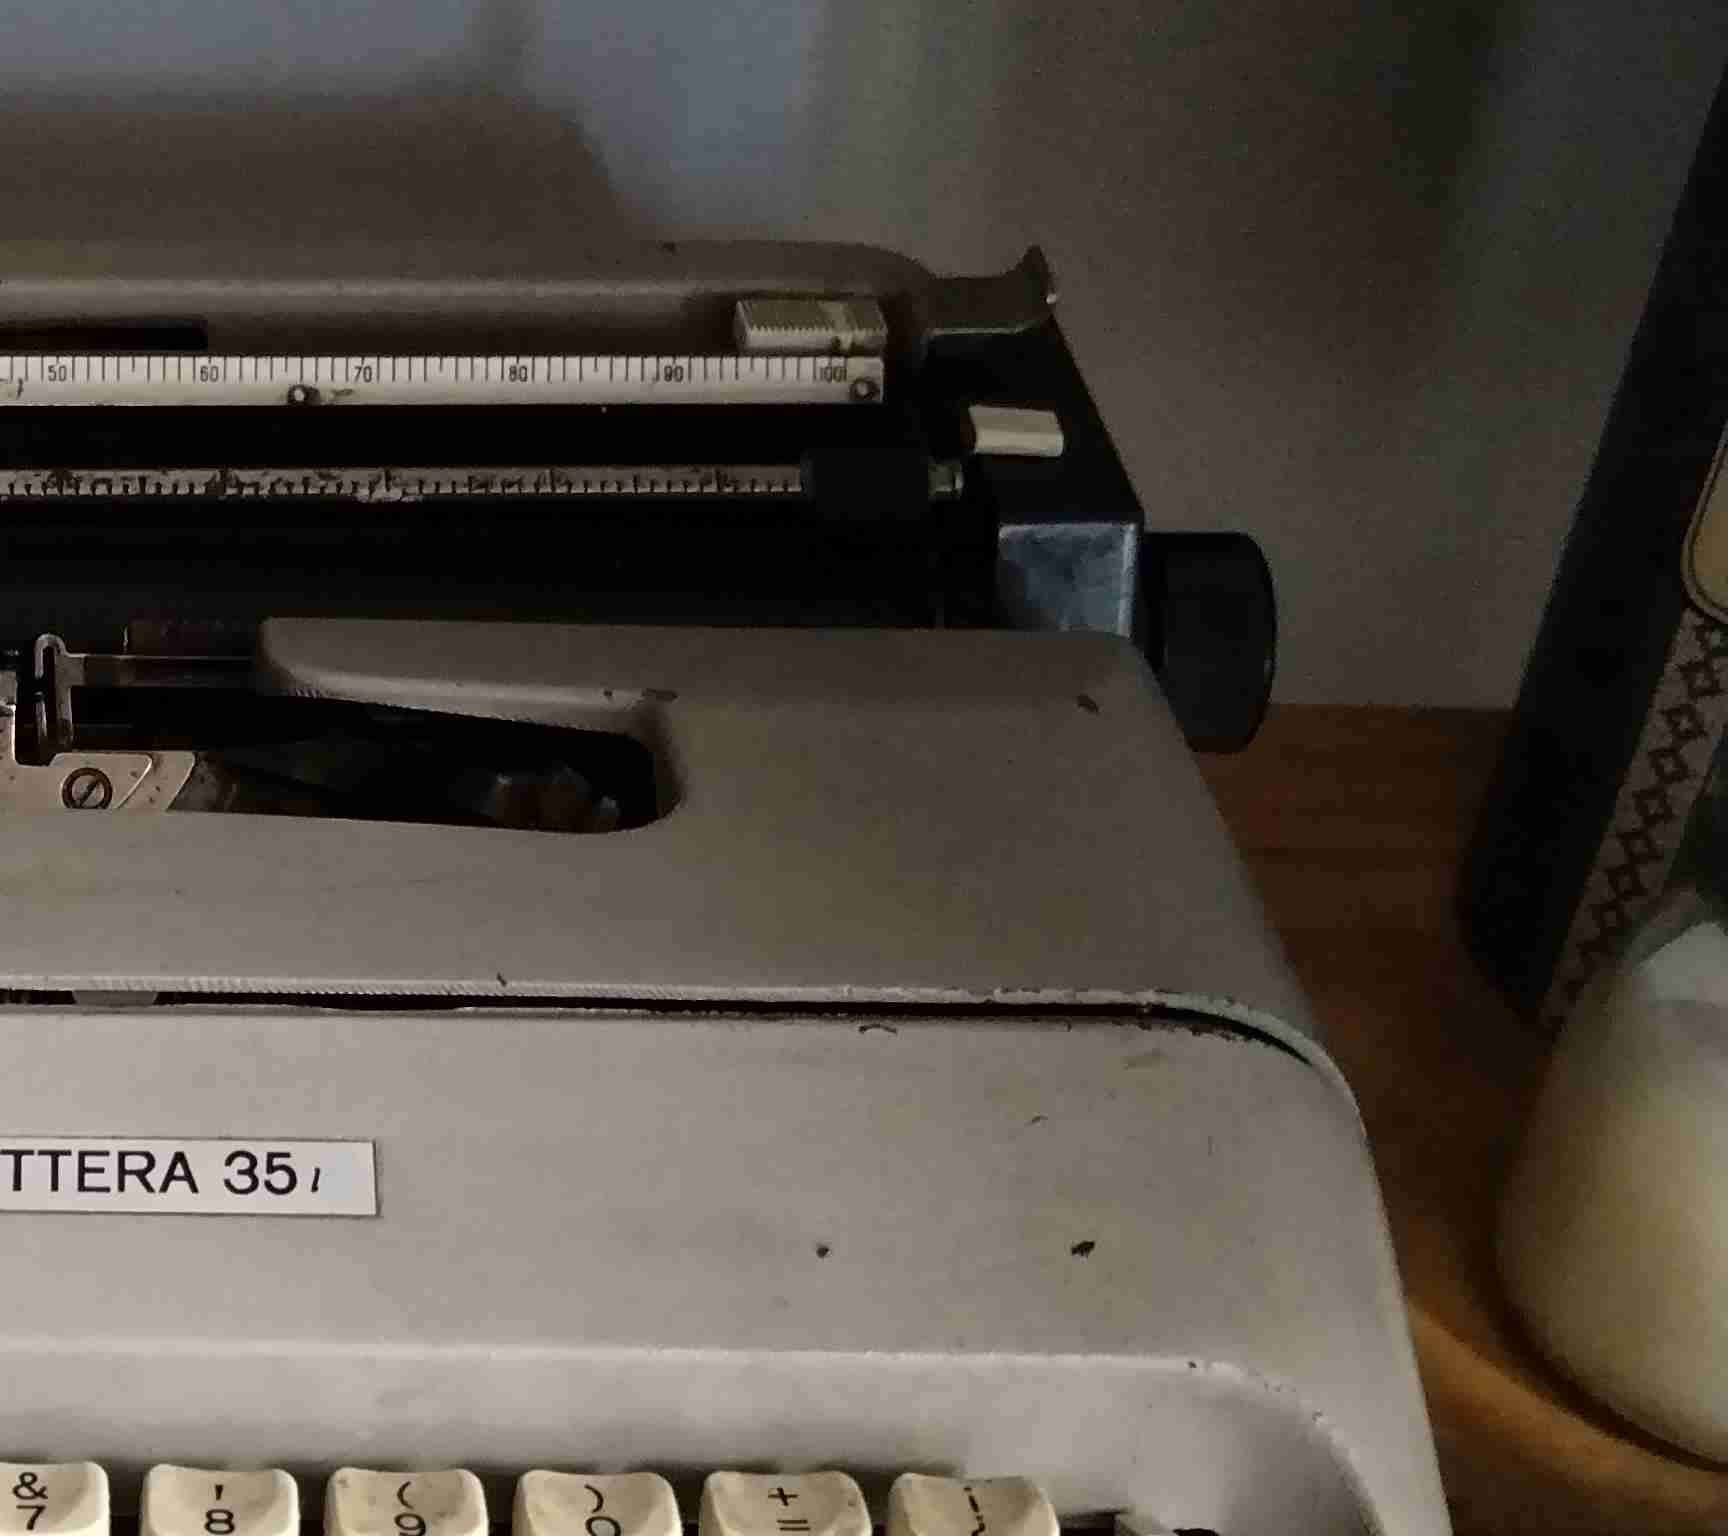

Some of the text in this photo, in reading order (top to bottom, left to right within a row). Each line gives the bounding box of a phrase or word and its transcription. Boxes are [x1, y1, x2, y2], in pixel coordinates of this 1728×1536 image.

[48, 364, 68, 383] 50
[199, 364, 220, 383] 60
[353, 364, 374, 384] 70
[508, 364, 529, 383] 80
[16, 1504, 47, 1531] 7
[204, 1508, 236, 1536] 8
